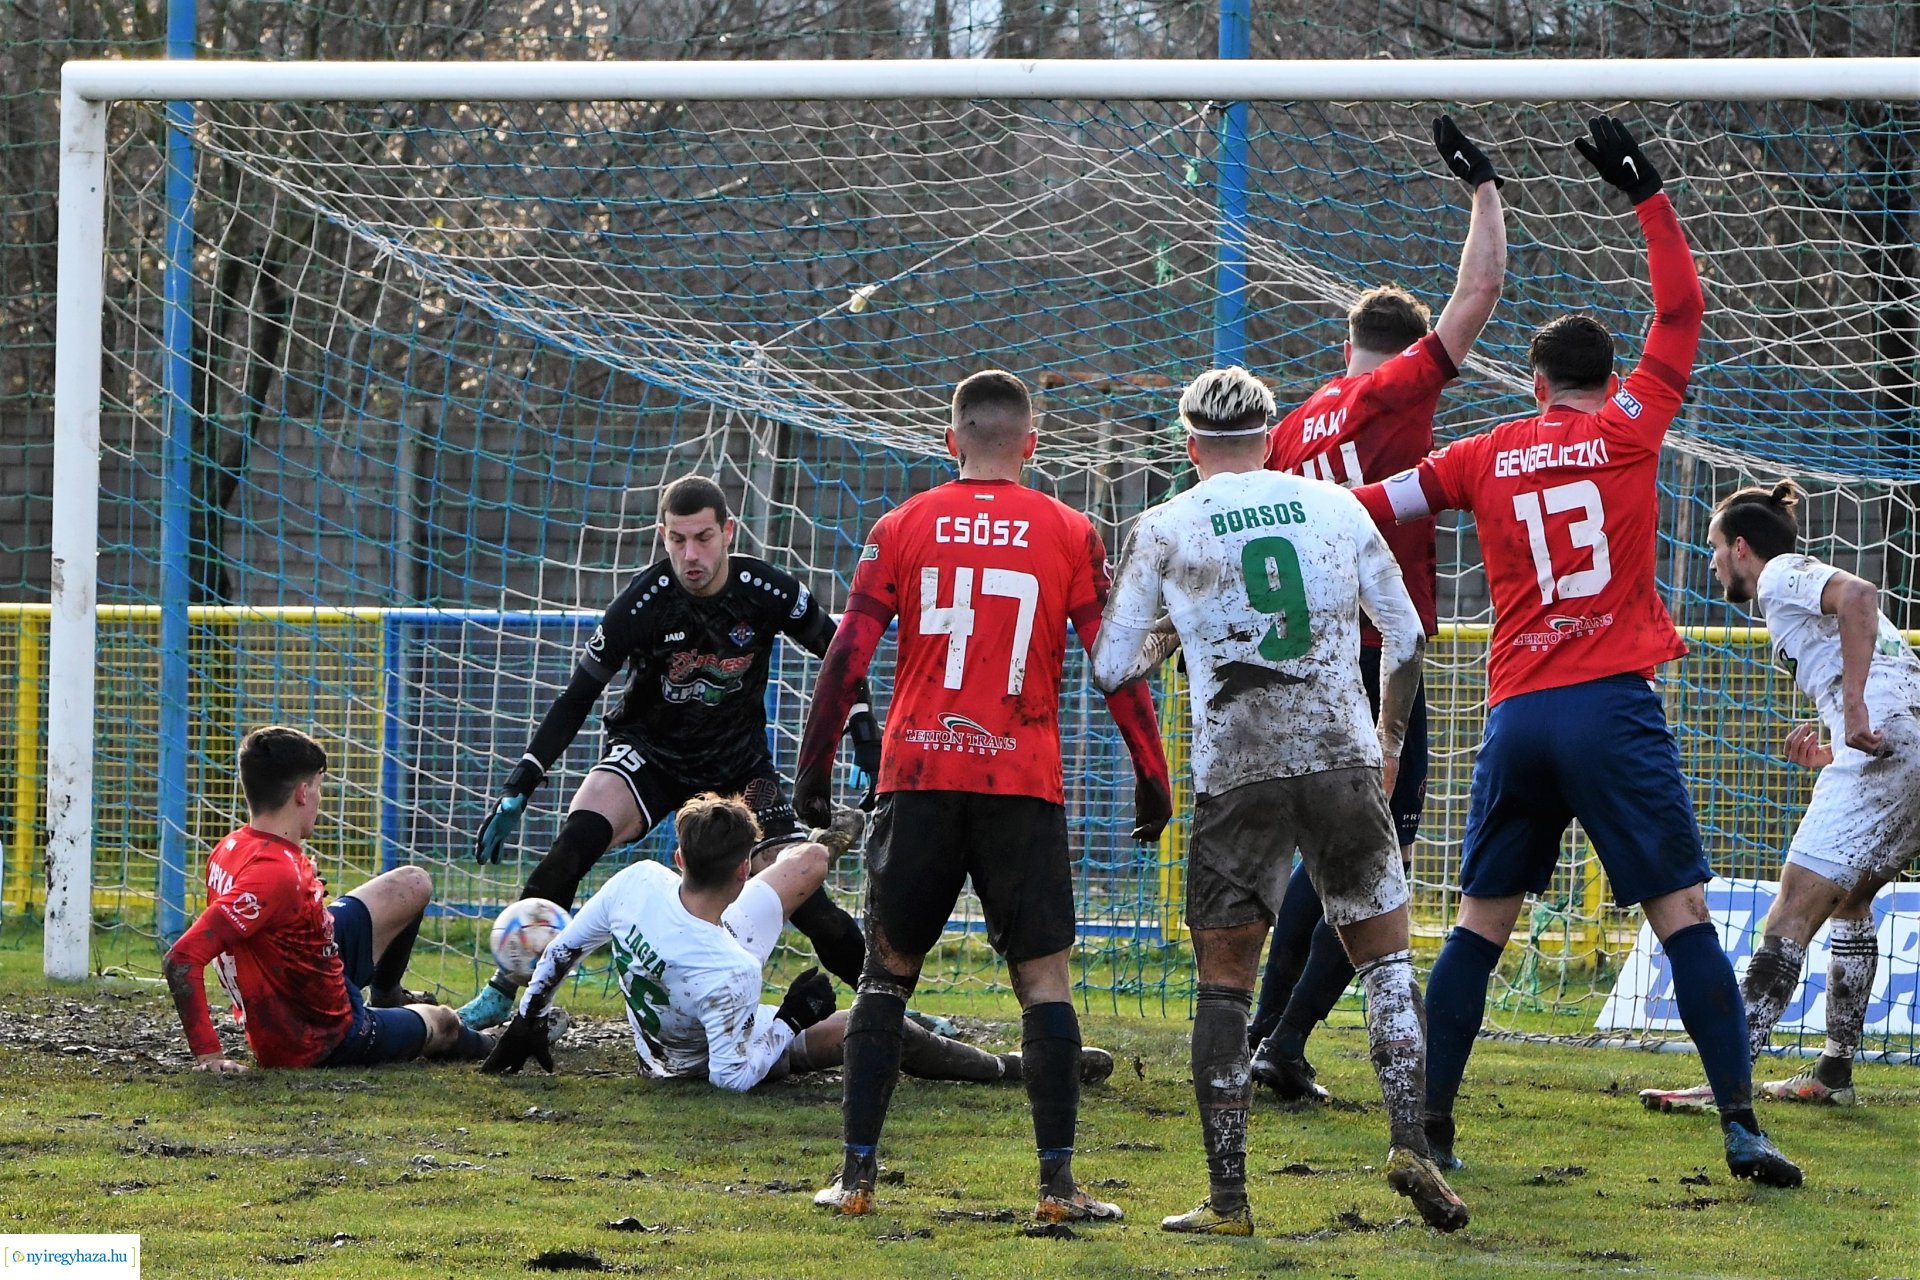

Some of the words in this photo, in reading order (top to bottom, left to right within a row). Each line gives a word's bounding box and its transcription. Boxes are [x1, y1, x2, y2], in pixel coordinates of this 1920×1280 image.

[1210, 500, 1307, 537] BORSOS
[1512, 479, 1613, 606] 13
[1241, 536, 1313, 662] 9
[663, 631, 686, 643] JAKO
[919, 566, 1040, 696] 47
[966, 733, 1018, 751] TRANS
[624, 923, 667, 980] LACZA
